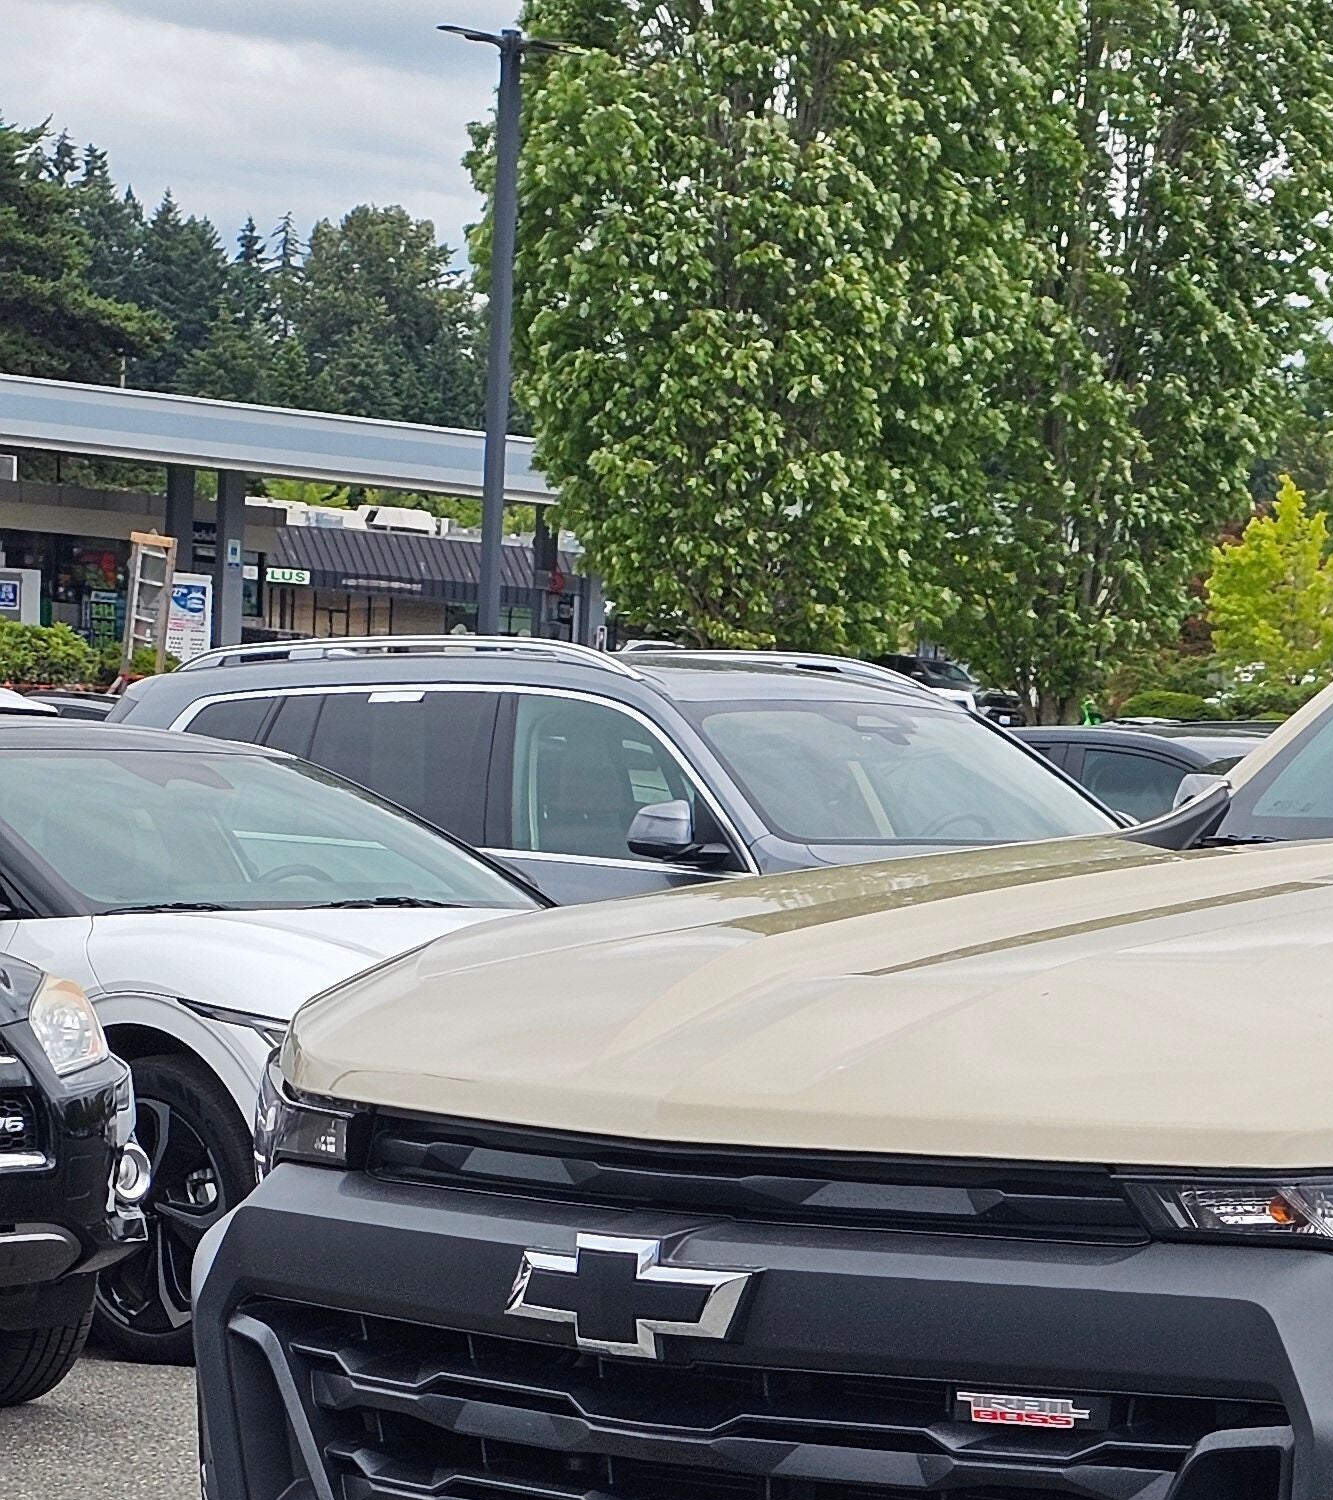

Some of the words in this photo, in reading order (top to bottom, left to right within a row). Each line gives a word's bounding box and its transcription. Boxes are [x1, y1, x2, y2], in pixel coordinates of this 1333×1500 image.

[266, 569, 306, 583] LUS
[956, 1391, 1091, 1419] TRAIL
[971, 1408, 1075, 1428] BOSS
